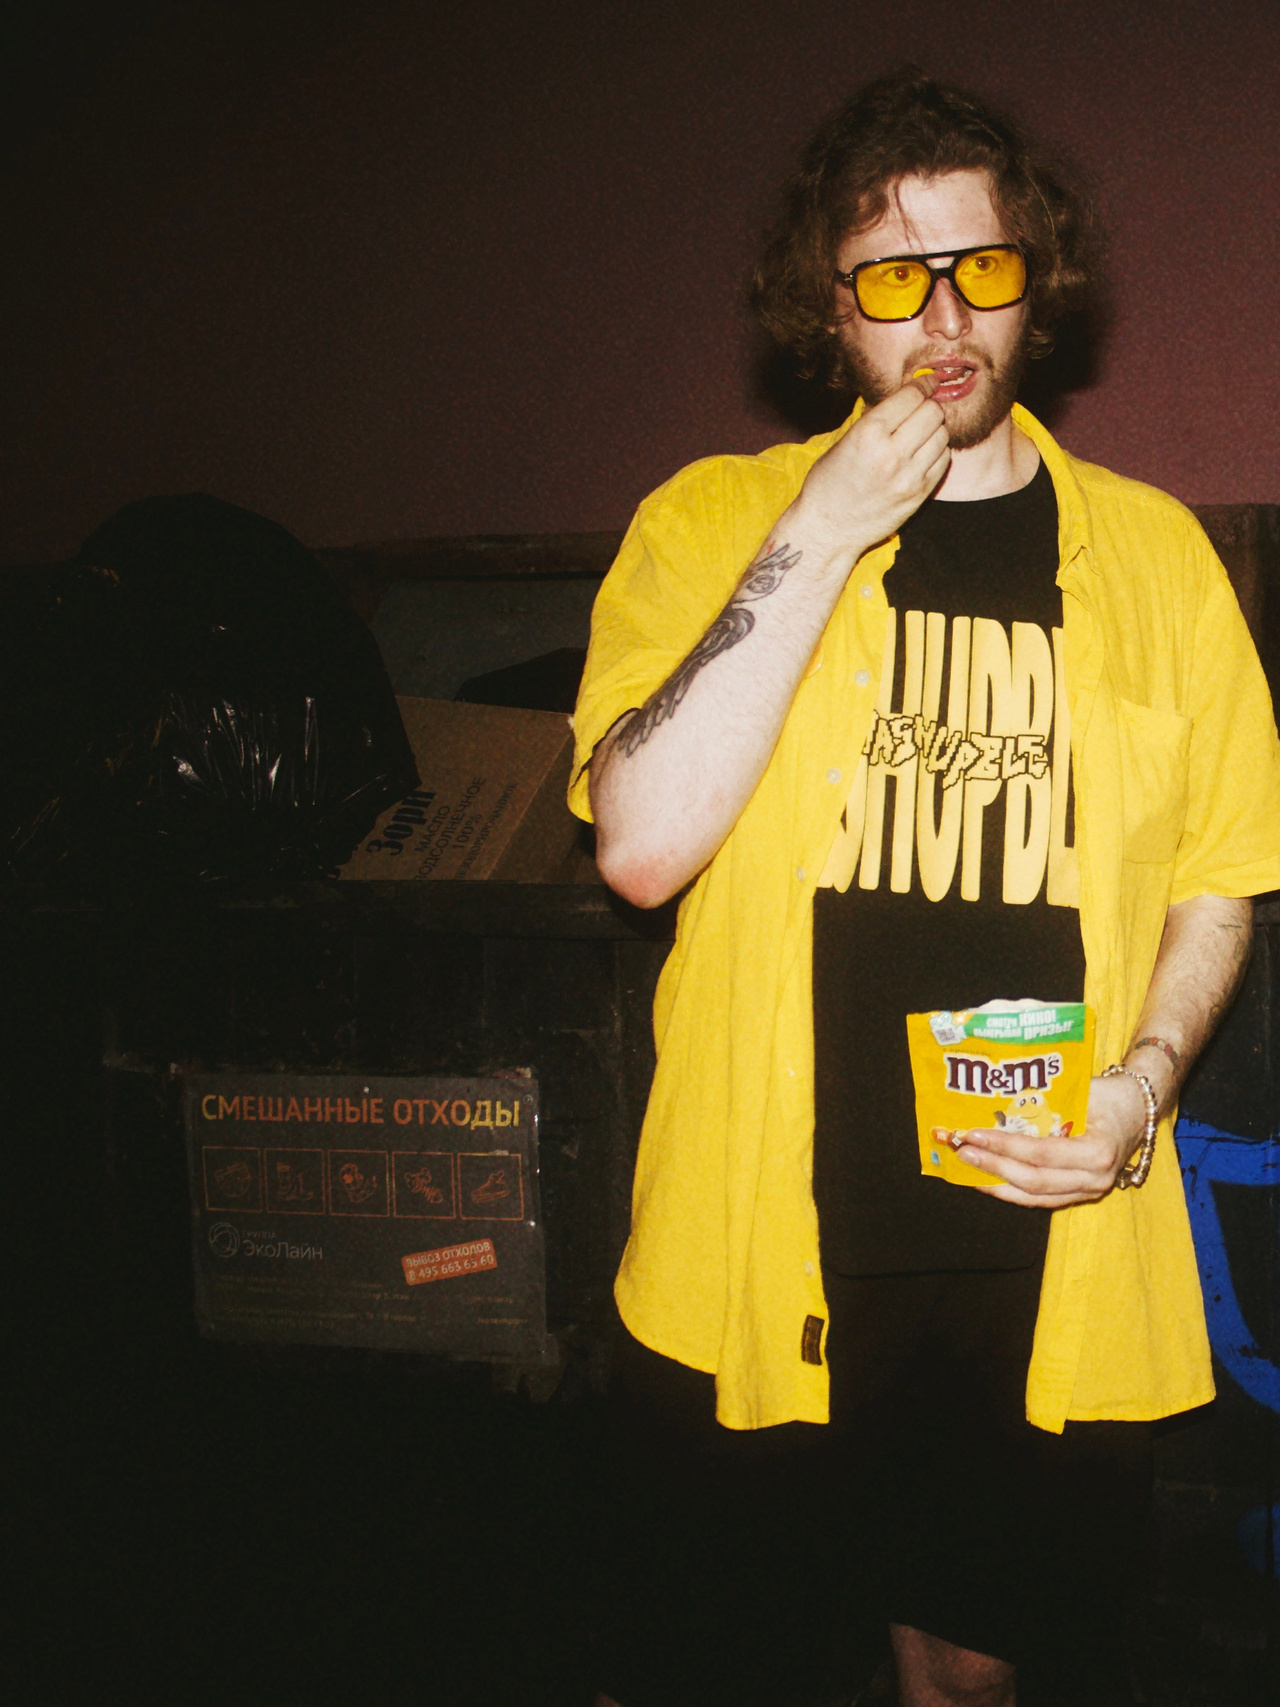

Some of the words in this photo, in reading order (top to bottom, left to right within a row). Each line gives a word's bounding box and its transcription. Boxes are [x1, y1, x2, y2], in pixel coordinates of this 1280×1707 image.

[415, 805, 451, 853] МАСЛО
[452, 813, 483, 850] 100%
[201, 1094, 385, 1124] СМЕШАННЫЕ
[392, 1098, 520, 1130] ОТХОДЫ
[242, 1239, 323, 1260] ЭкоЛайн
[405, 1252, 441, 1268] ВЫВОЗ
[408, 1270, 416, 1281] 8
[418, 1266, 439, 1278] 495
[441, 1261, 462, 1274] 663
